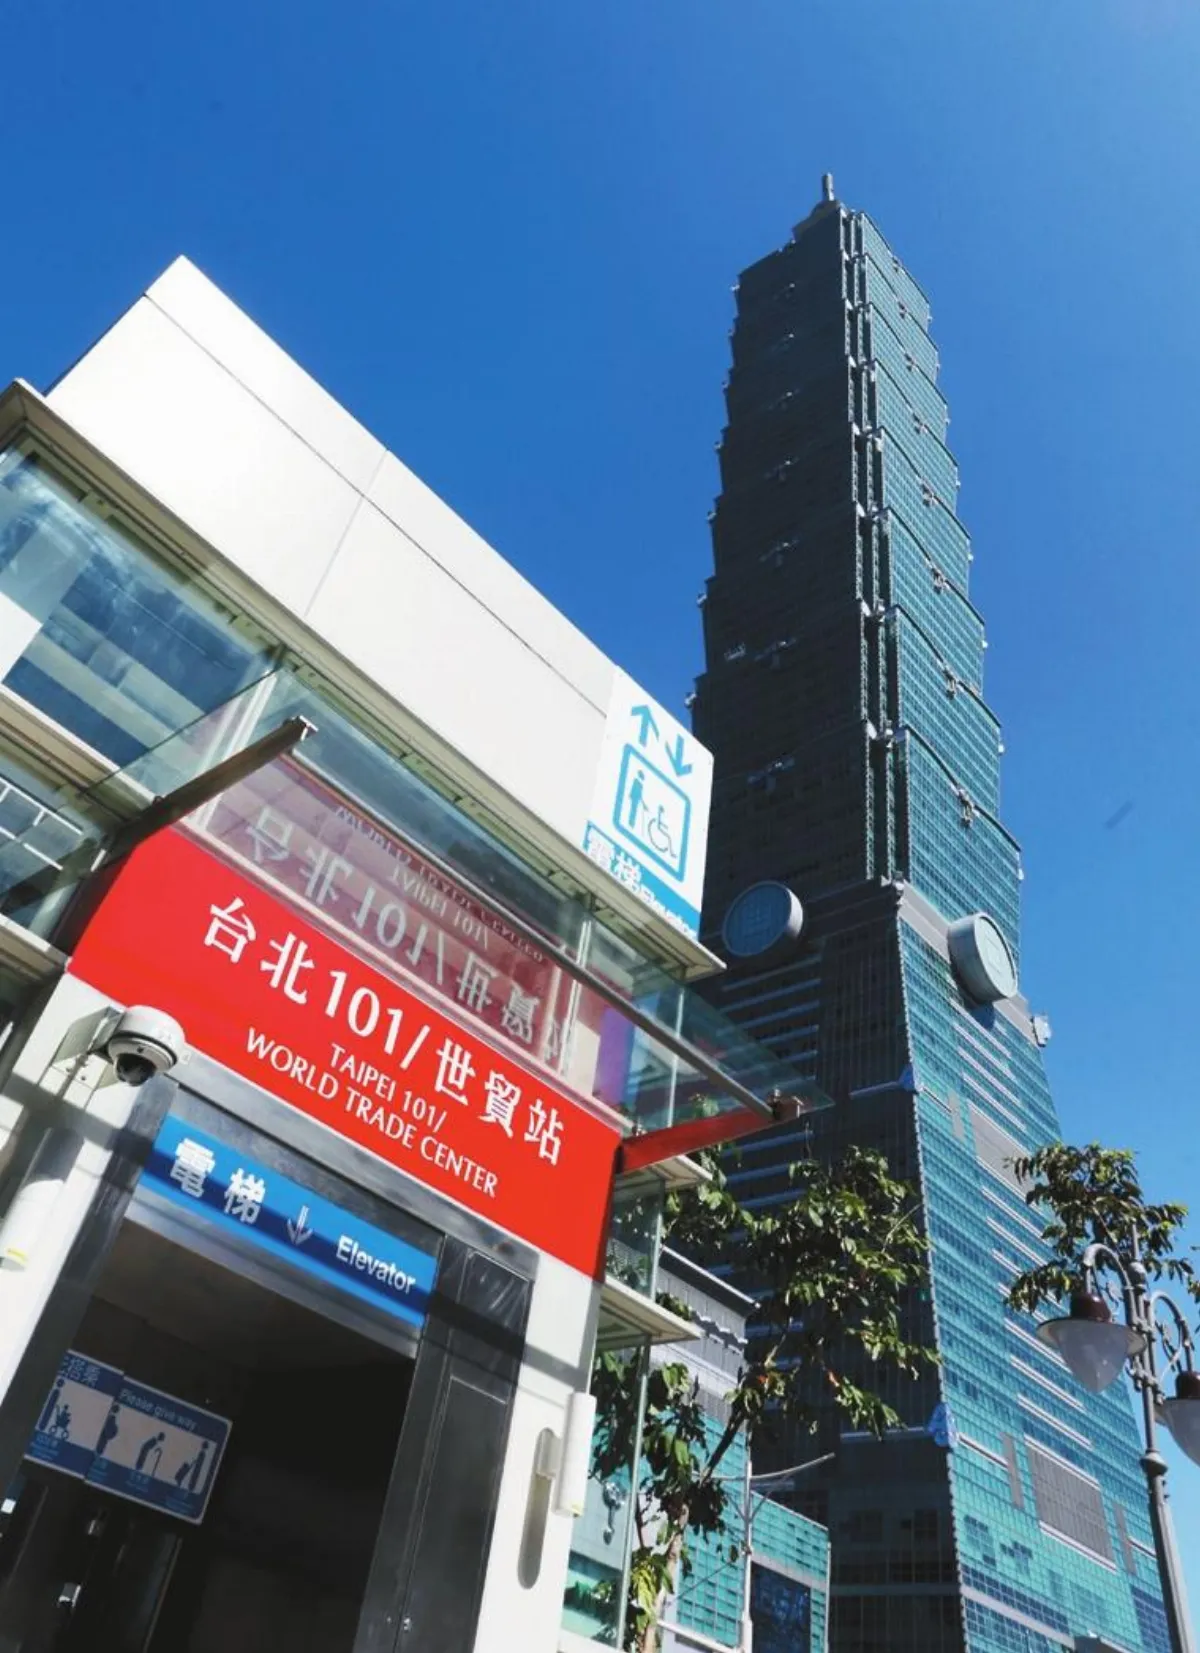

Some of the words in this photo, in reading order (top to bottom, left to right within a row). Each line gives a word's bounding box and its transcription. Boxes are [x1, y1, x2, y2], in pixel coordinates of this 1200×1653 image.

[247, 1027, 339, 1099] WORLD
[345, 1086, 417, 1149] TRADE
[420, 1136, 498, 1198] CENTER
[330, 1043, 397, 1102] TAIPEI
[403, 1090, 447, 1133] 101/
[170, 1137, 266, 1223] 電梯
[336, 1235, 416, 1293] Elevator
[119, 1387, 153, 1412] Please
[154, 1405, 176, 1423] give
